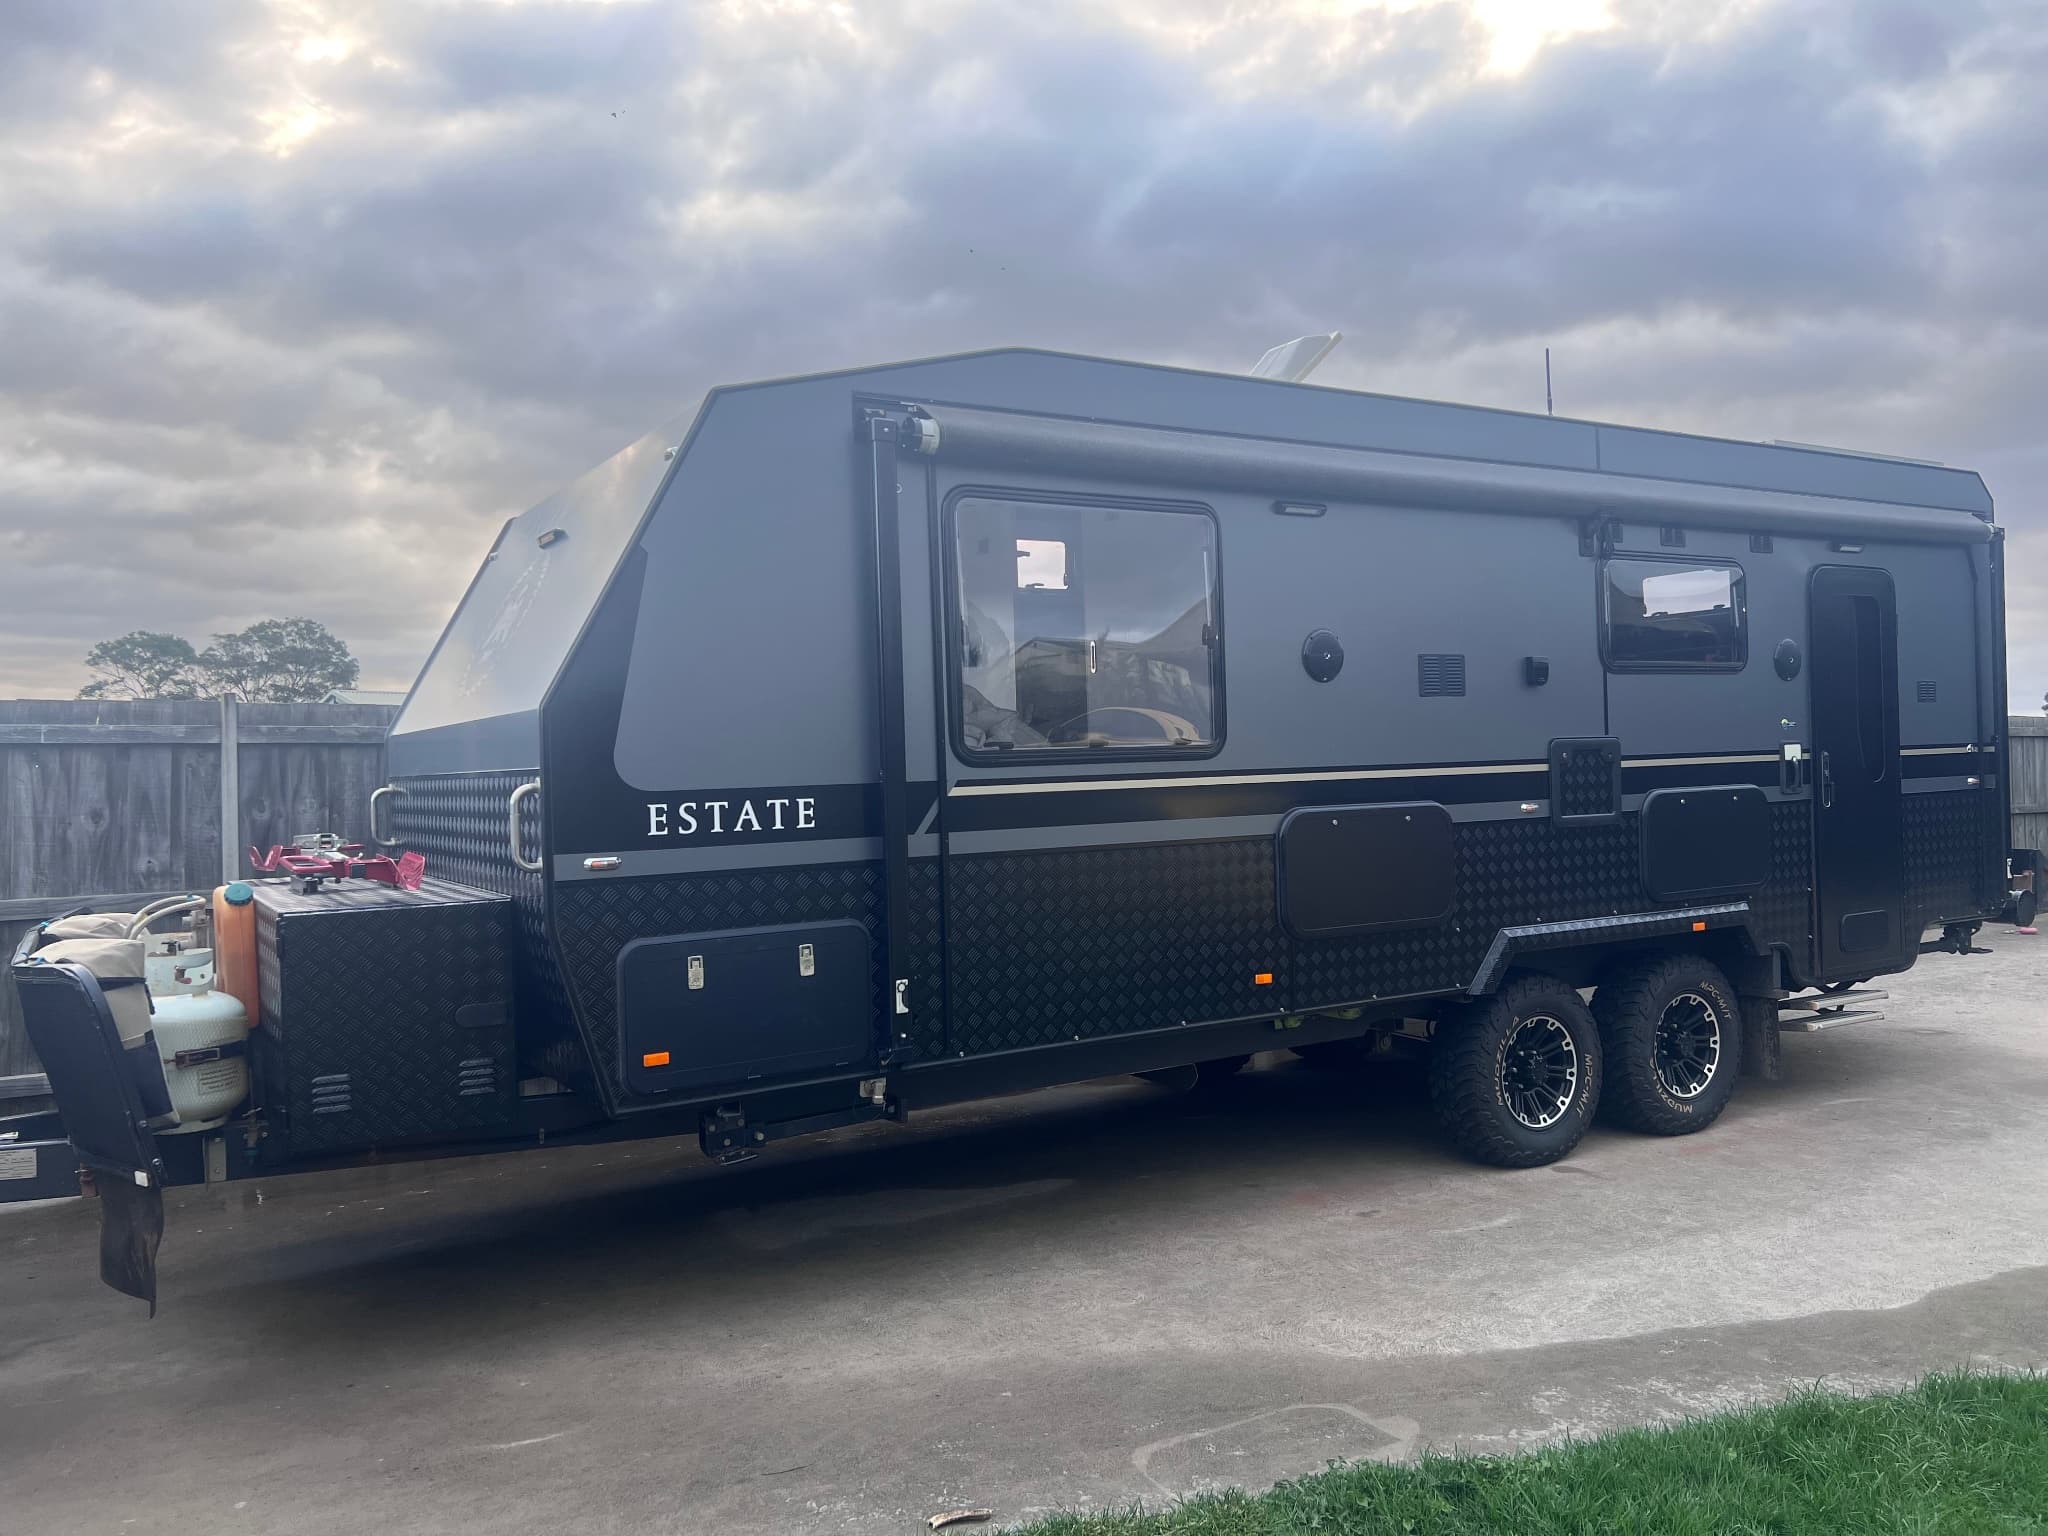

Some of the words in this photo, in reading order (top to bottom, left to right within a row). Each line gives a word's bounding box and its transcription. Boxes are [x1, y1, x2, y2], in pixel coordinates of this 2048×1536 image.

[647, 798, 816, 836] ESTATE
[1699, 980, 1732, 1019] MPC-M/T
[1576, 1053, 1593, 1118] MPC-M/T
